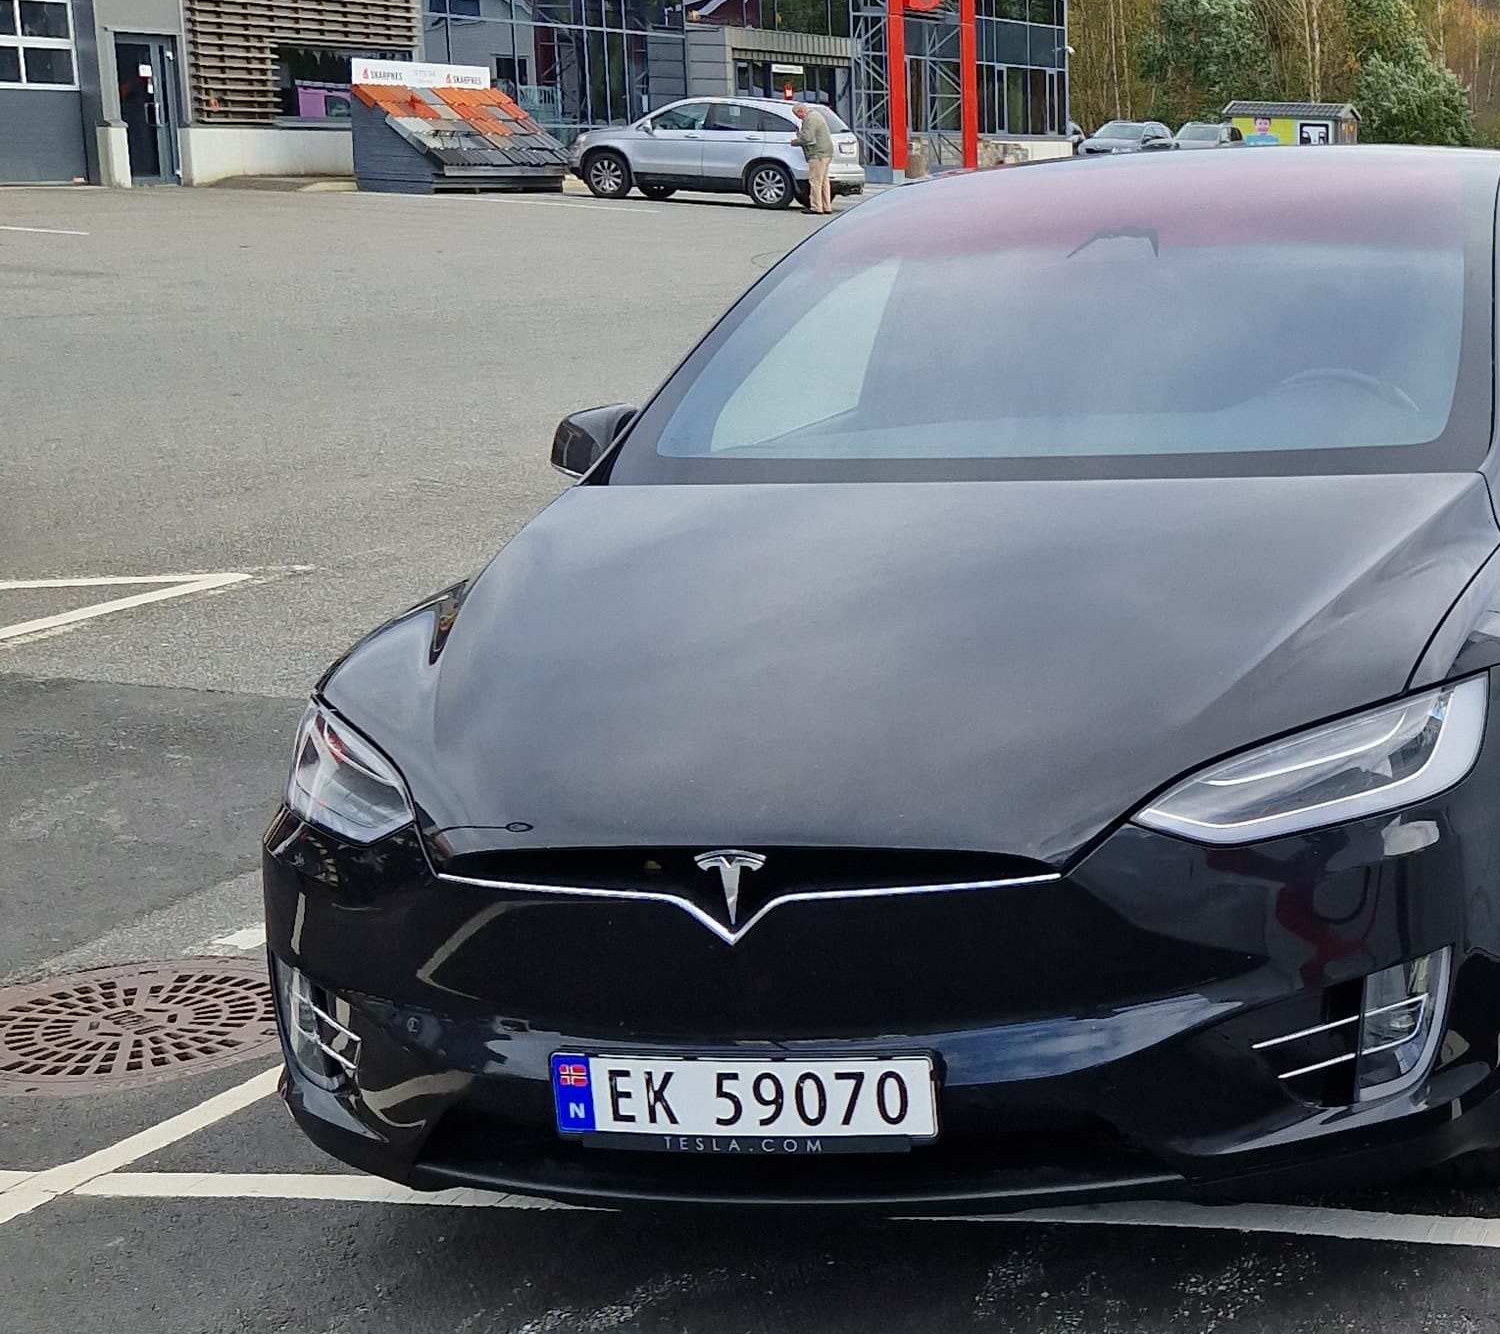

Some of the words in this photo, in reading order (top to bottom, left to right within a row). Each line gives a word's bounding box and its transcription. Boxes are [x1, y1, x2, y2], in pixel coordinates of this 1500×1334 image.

[608, 1069, 680, 1125] EK
[716, 1071, 908, 1127] 59070
[569, 1102, 586, 1119] N
[664, 1136, 823, 1153] TESLA.COM
